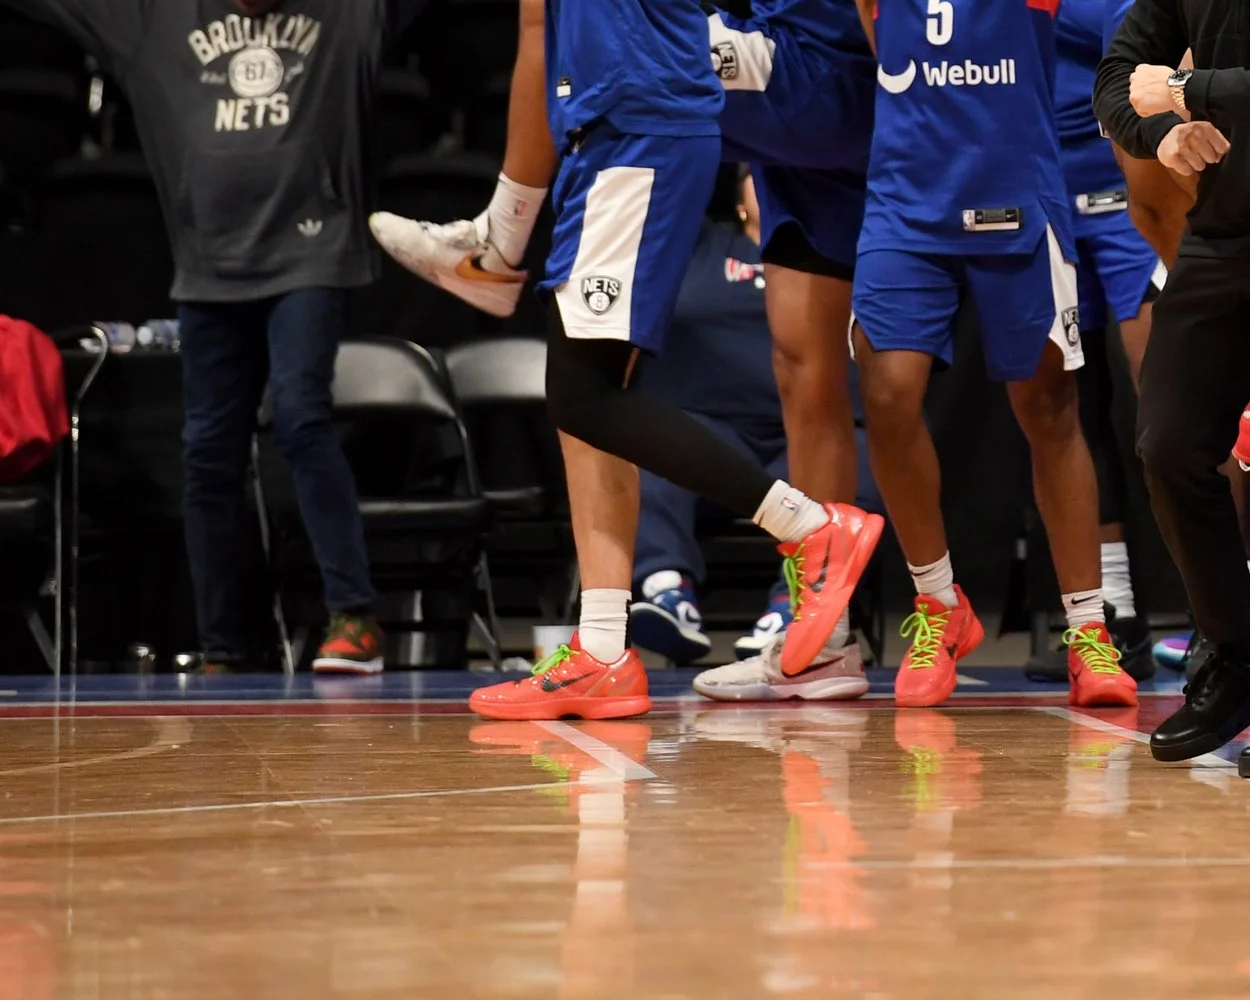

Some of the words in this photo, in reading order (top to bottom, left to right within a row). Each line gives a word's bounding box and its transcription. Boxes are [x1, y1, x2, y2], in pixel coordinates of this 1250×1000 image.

[922, 59, 1016, 87] Webull
[214, 91, 290, 132] NETS
[583, 277, 619, 297] NETS
